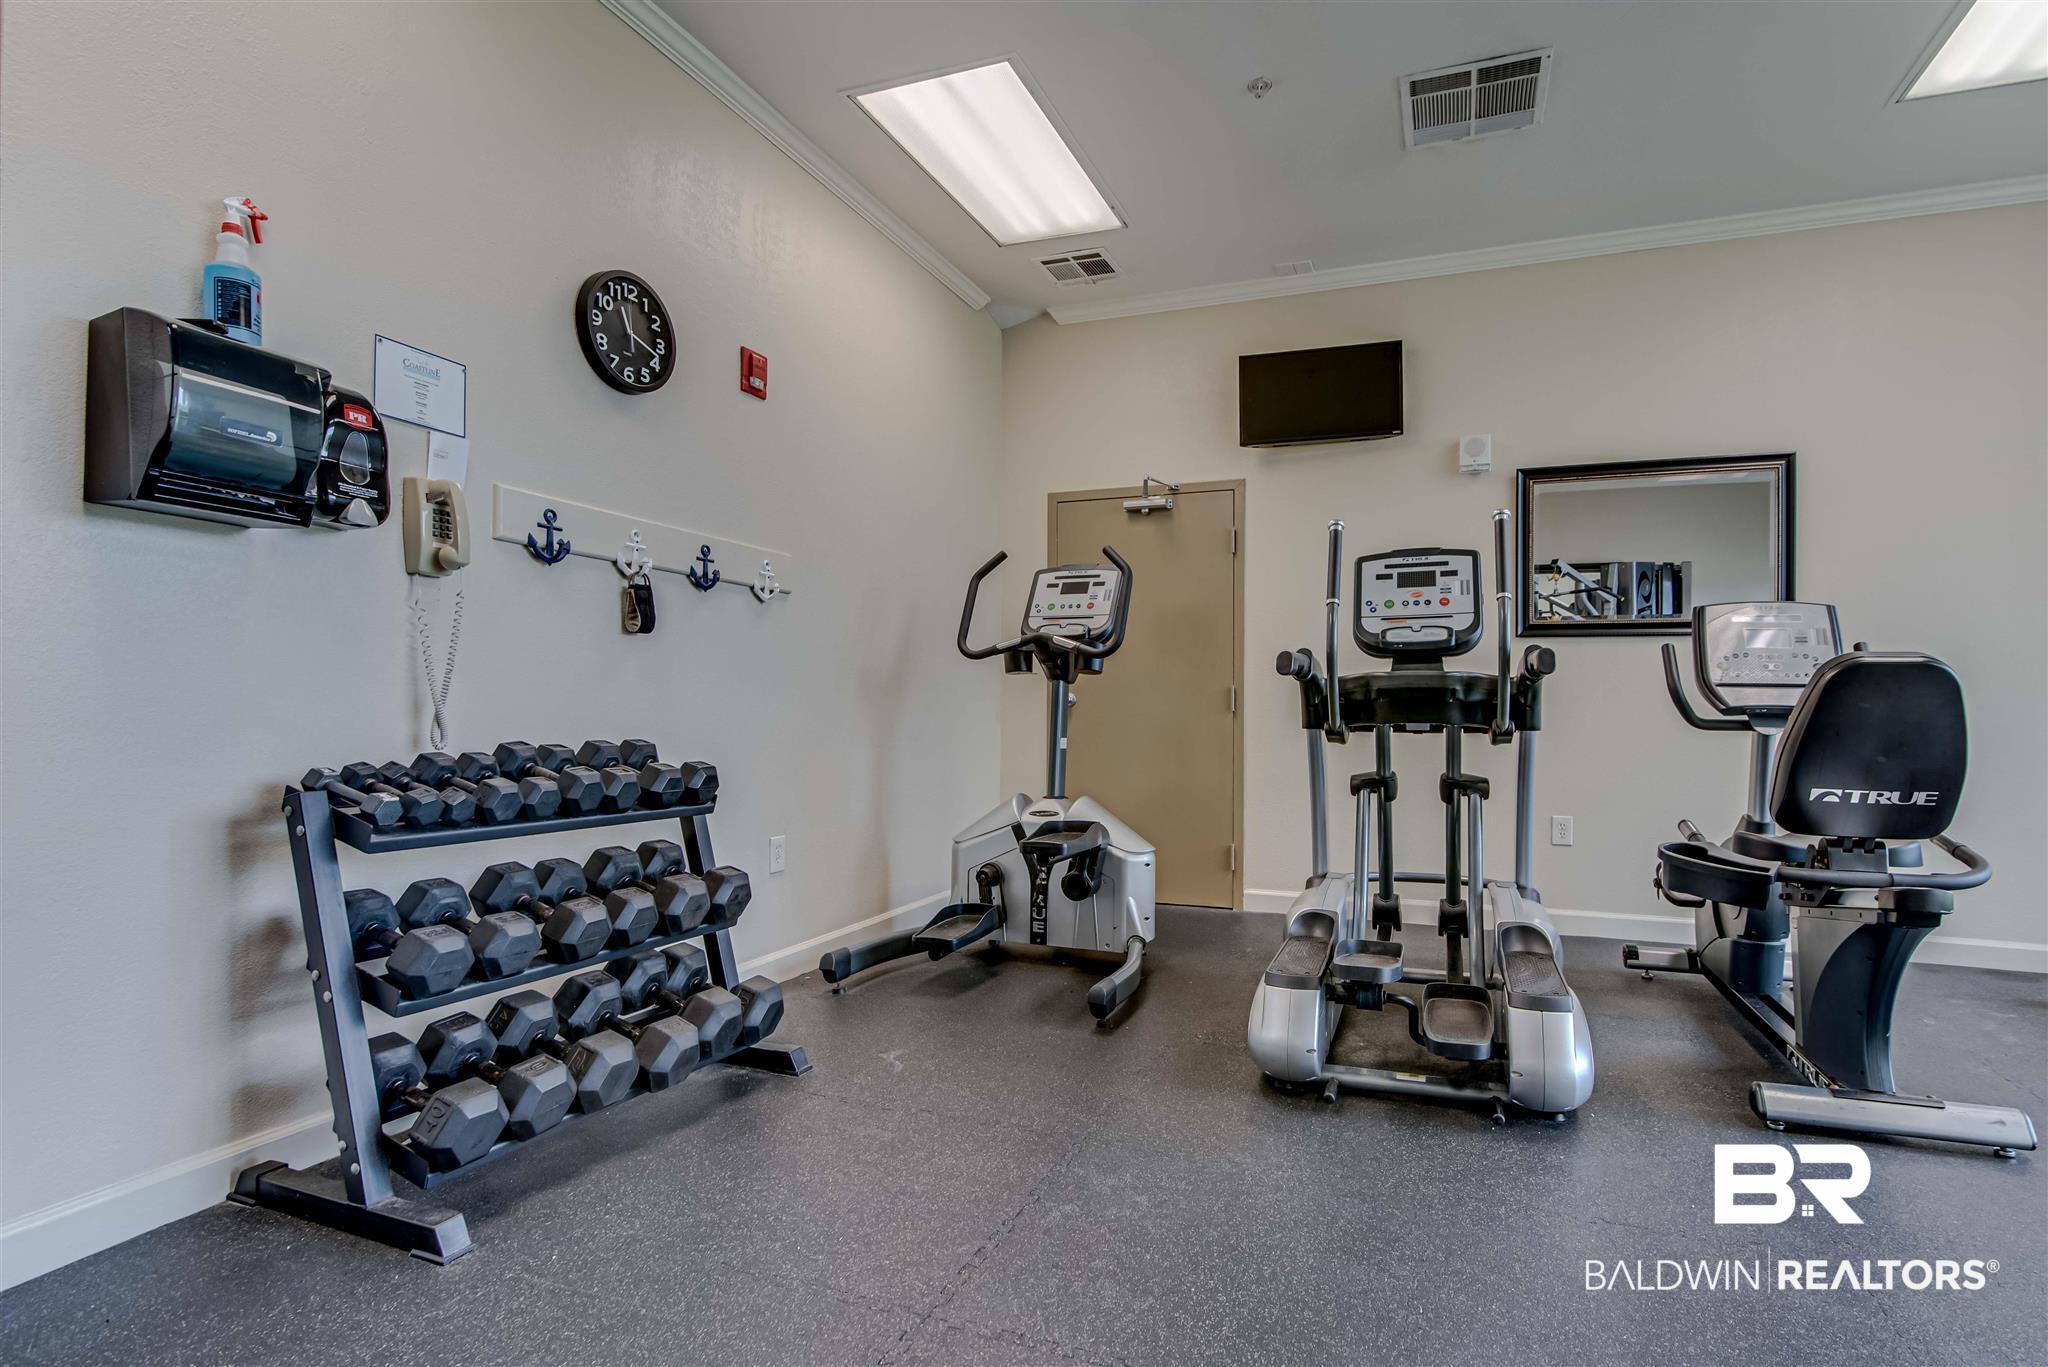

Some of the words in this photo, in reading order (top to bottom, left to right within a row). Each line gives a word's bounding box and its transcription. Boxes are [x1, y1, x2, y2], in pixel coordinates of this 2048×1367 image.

[608, 281, 621, 300] 11
[622, 282, 638, 303] 12
[596, 292, 614, 311] 10
[642, 298, 649, 312] 1
[592, 309, 603, 326] 9
[651, 315, 661, 332] 2
[595, 332, 608, 351] 8
[655, 338, 665, 355] 3
[609, 354, 620, 369] 7
[649, 356, 661, 372] 4
[623, 366, 635, 384] 6
[640, 367, 650, 383] 5
[1844, 789, 1939, 806] TRUE
